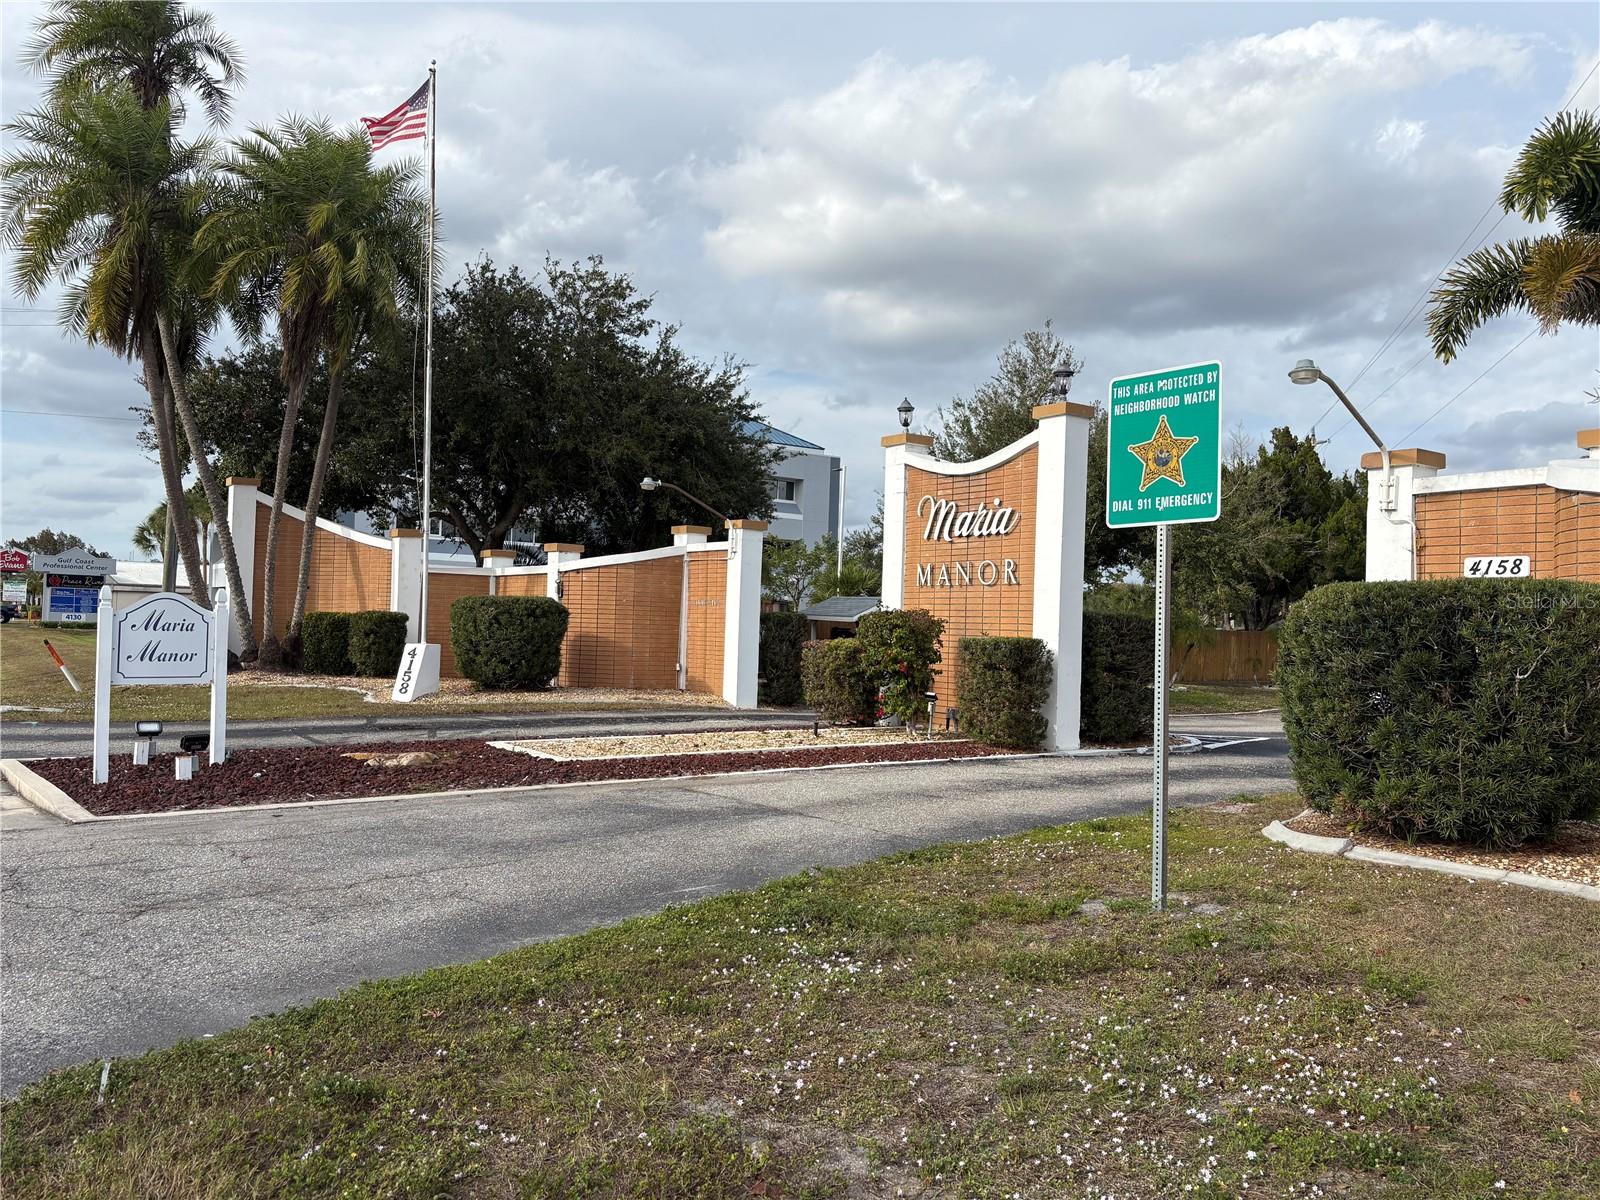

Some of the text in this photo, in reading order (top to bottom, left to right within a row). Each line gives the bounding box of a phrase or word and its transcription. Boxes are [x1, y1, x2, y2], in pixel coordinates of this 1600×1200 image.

[1113, 370, 1218, 399] THIS AREA PROTECTED BY
[1114, 389, 1216, 416] NEIGHBORHOOD WATCH
[1112, 492, 1213, 512] DIAL 911 EMERGENCY
[917, 495, 1021, 542] Maria
[4, 553, 20, 562] Bob
[42, 562, 84, 570] Professional
[1469, 558, 1523, 575] 4158
[915, 559, 1019, 587] MANOR
[130, 609, 195, 632] Maria
[126, 639, 198, 663] Manor
[399, 647, 417, 695] 4158
